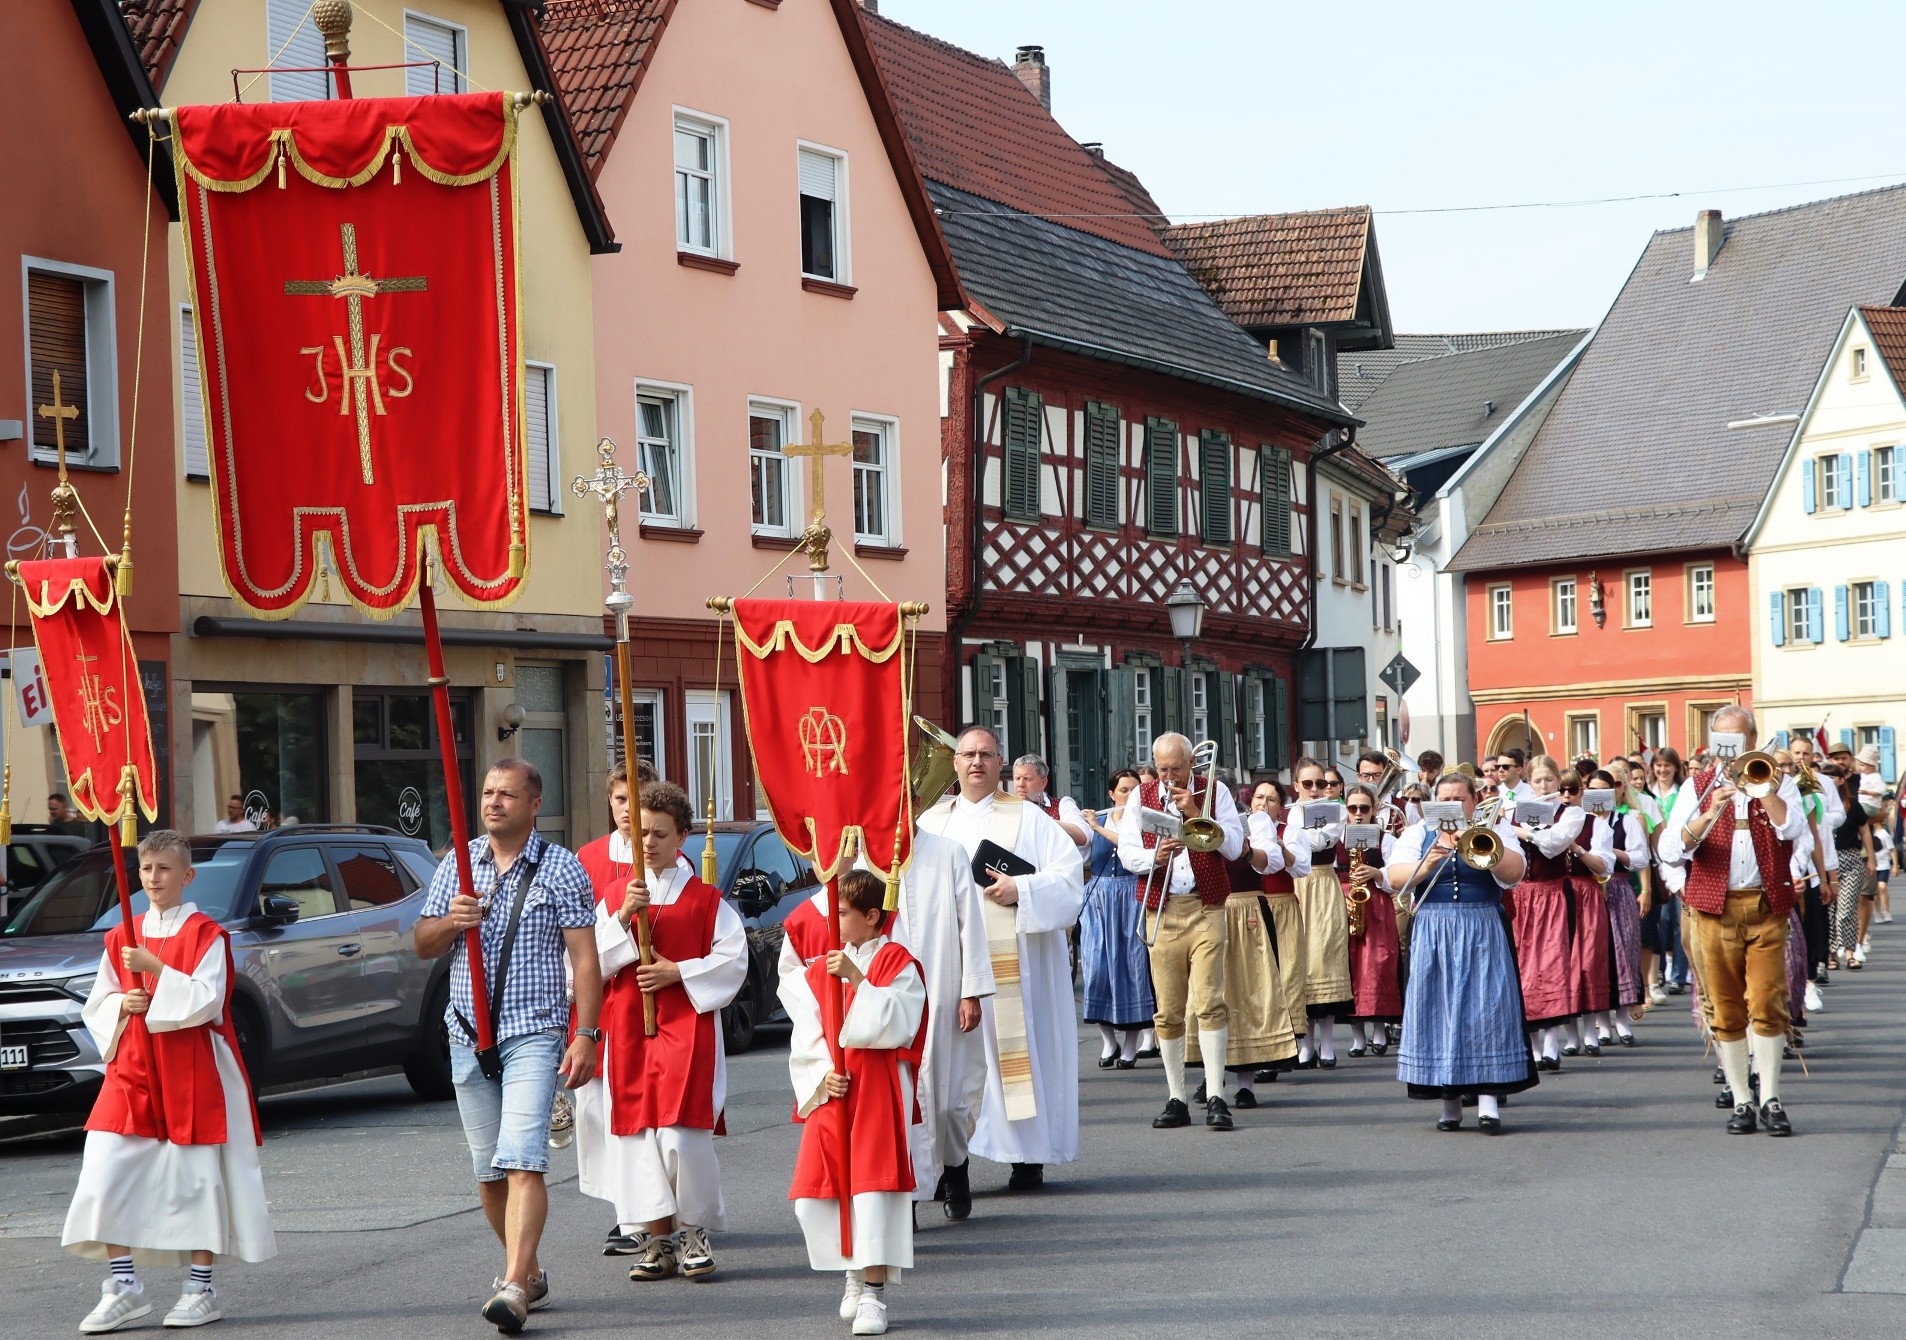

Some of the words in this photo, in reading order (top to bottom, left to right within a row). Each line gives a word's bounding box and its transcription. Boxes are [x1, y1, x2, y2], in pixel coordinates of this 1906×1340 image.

[22, 664, 47, 719] Ei
[244, 805, 269, 830] Café
[399, 801, 421, 824] Café
[1, 1048, 26, 1066] 111
